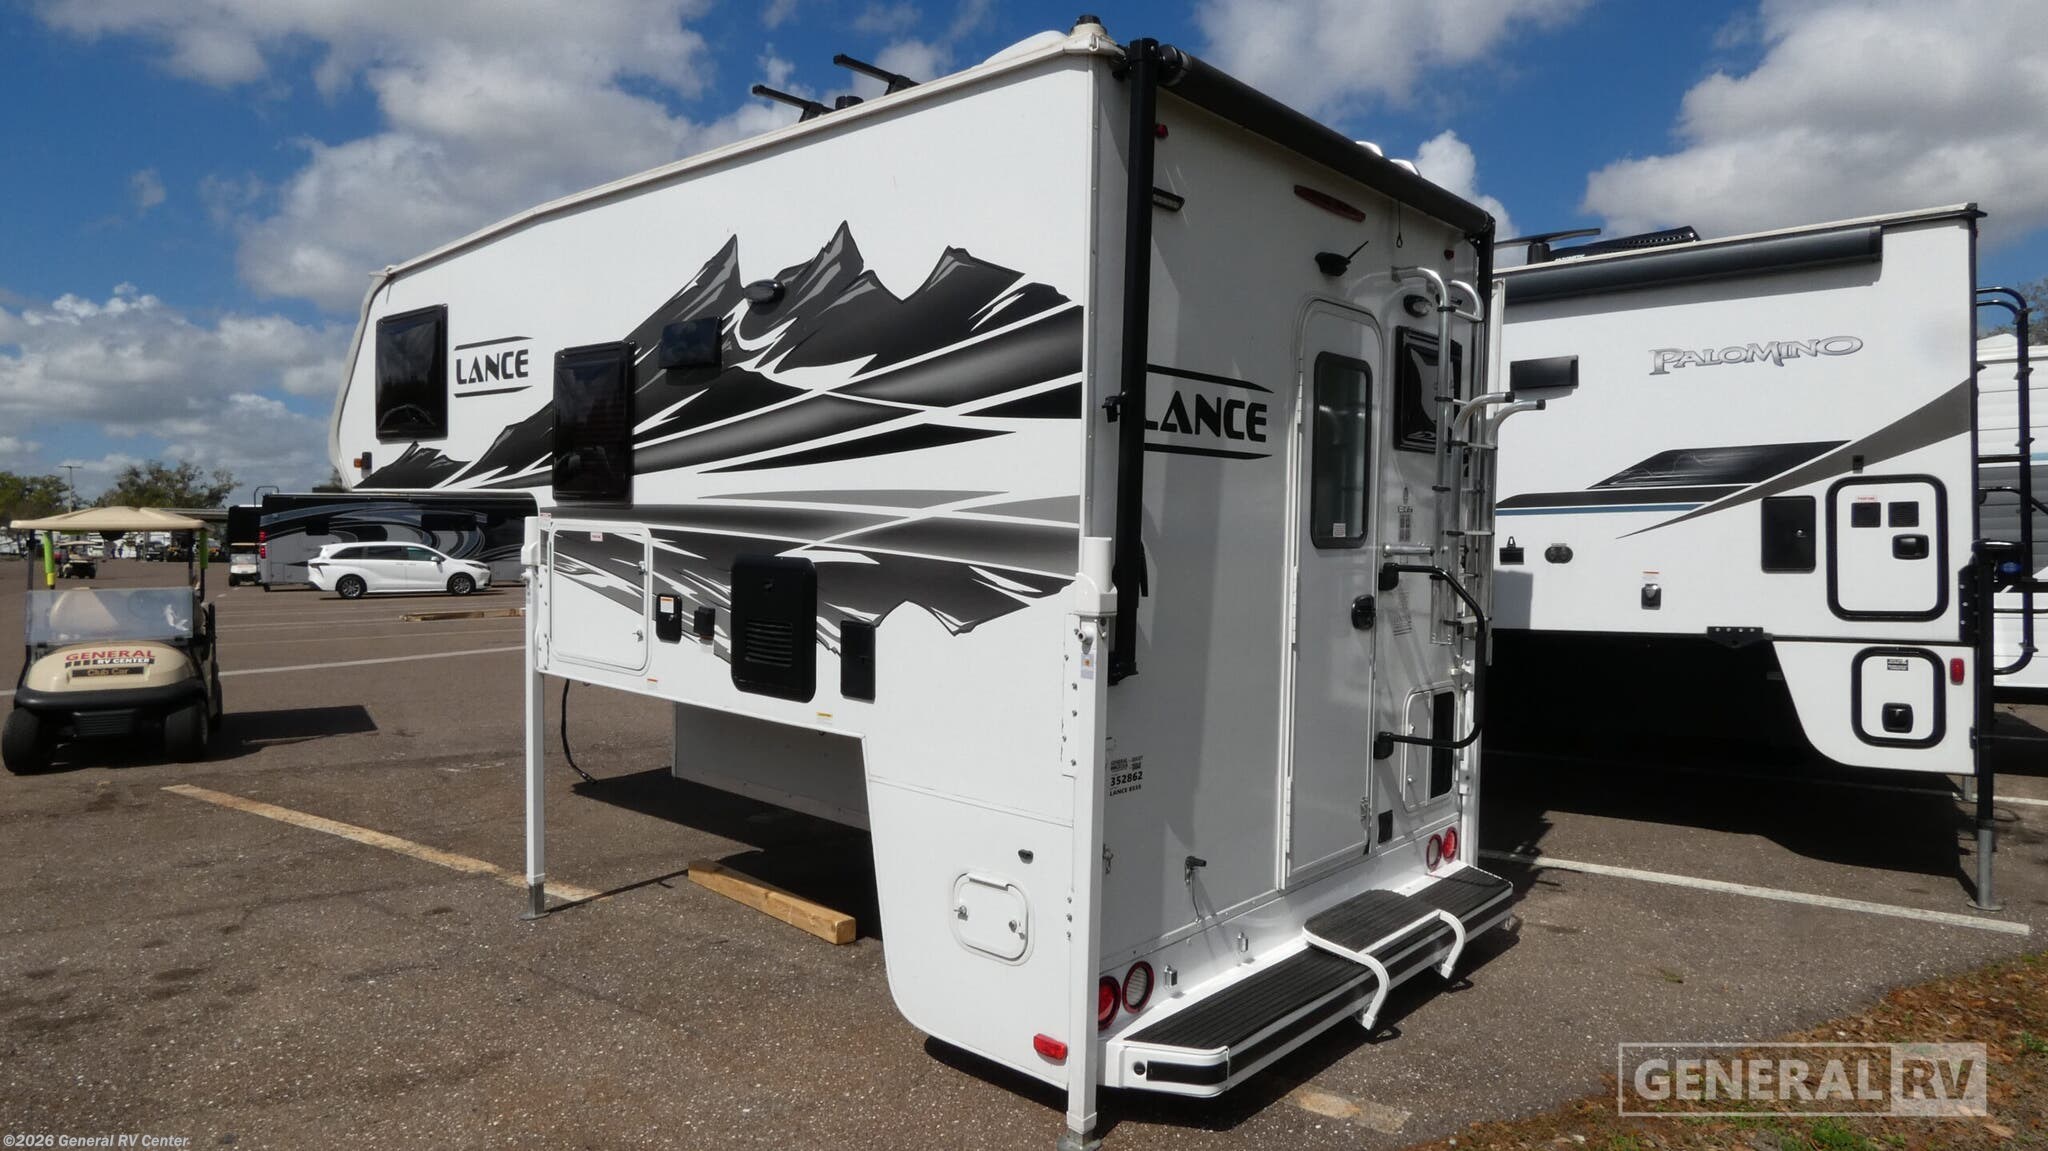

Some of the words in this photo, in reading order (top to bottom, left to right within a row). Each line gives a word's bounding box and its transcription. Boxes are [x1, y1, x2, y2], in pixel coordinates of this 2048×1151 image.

[456, 348, 529, 385] LANCE
[66, 650, 156, 661] GENERAL
[111, 667, 129, 675] Car
[1110, 771, 1143, 786] 352862
